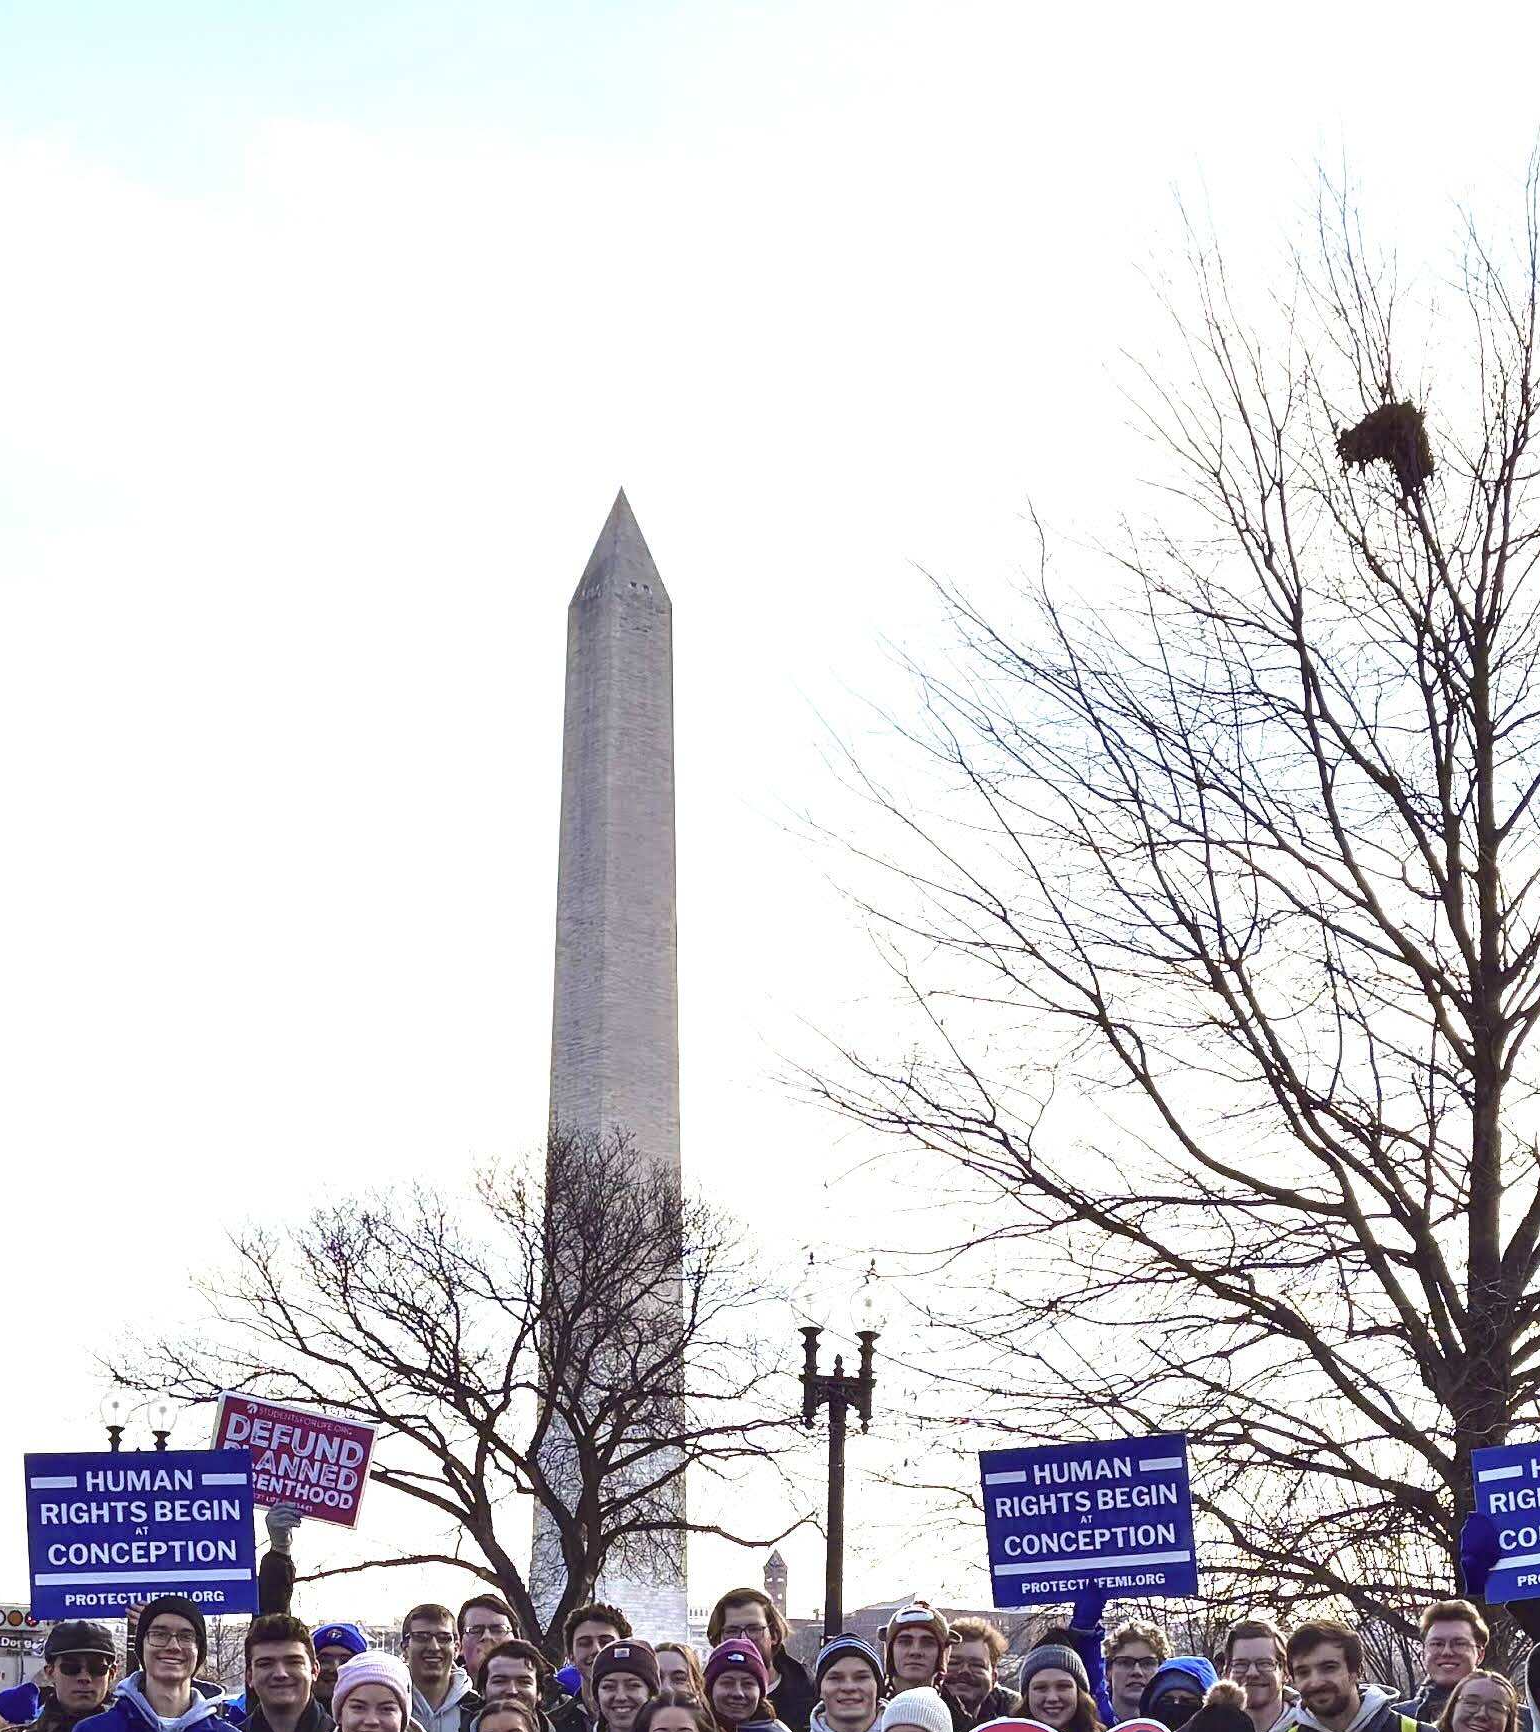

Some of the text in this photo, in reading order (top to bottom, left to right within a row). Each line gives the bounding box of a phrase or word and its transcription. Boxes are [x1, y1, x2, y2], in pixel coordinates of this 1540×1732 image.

[225, 1412, 364, 1468] DEFUND
[86, 1469, 193, 1492] HUMAN
[1034, 1457, 1132, 1485] HUMAN
[40, 1501, 148, 1524] RIGHTS
[154, 1499, 241, 1522] BEGIN
[995, 1483, 1178, 1518] RIGHTS BEGIN
[135, 1526, 149, 1536] AT
[1080, 1515, 1093, 1524] AT
[47, 1539, 237, 1566] CONCEPTION
[1004, 1523, 1175, 1556] CONCEPTION
